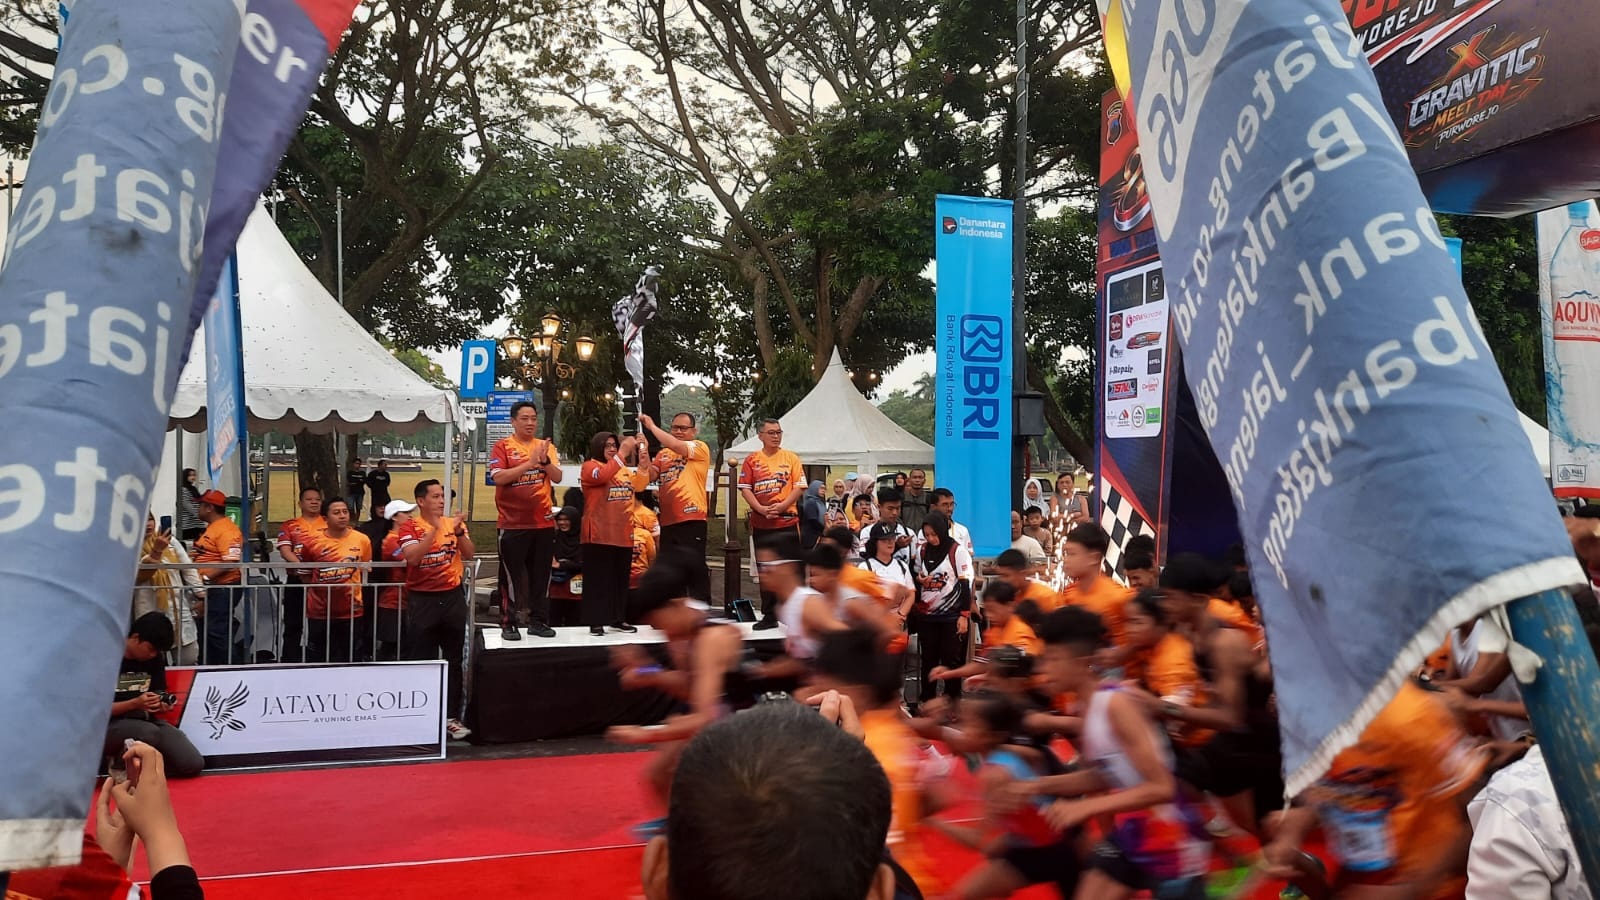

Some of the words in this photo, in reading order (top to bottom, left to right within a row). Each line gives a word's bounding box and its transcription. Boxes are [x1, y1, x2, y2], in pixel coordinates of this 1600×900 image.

[1409, 37, 1541, 127] GRAVITIC
[1432, 97, 1476, 131] MEET
[1477, 80, 1511, 108] DAY
[1438, 105, 1500, 144] PURWOREJO
[959, 216, 1007, 230] Danantara
[959, 227, 1003, 239] Indonesia
[946, 315, 956, 341] Bank
[466, 347, 489, 390] P
[945, 345, 956, 383] Rakyat
[946, 386, 956, 437] Indonesia
[963, 366, 1000, 440] BRI
[261, 693, 348, 717] JATAYU
[357, 690, 428, 711] GOLD
[354, 714, 378, 722] EMAS
